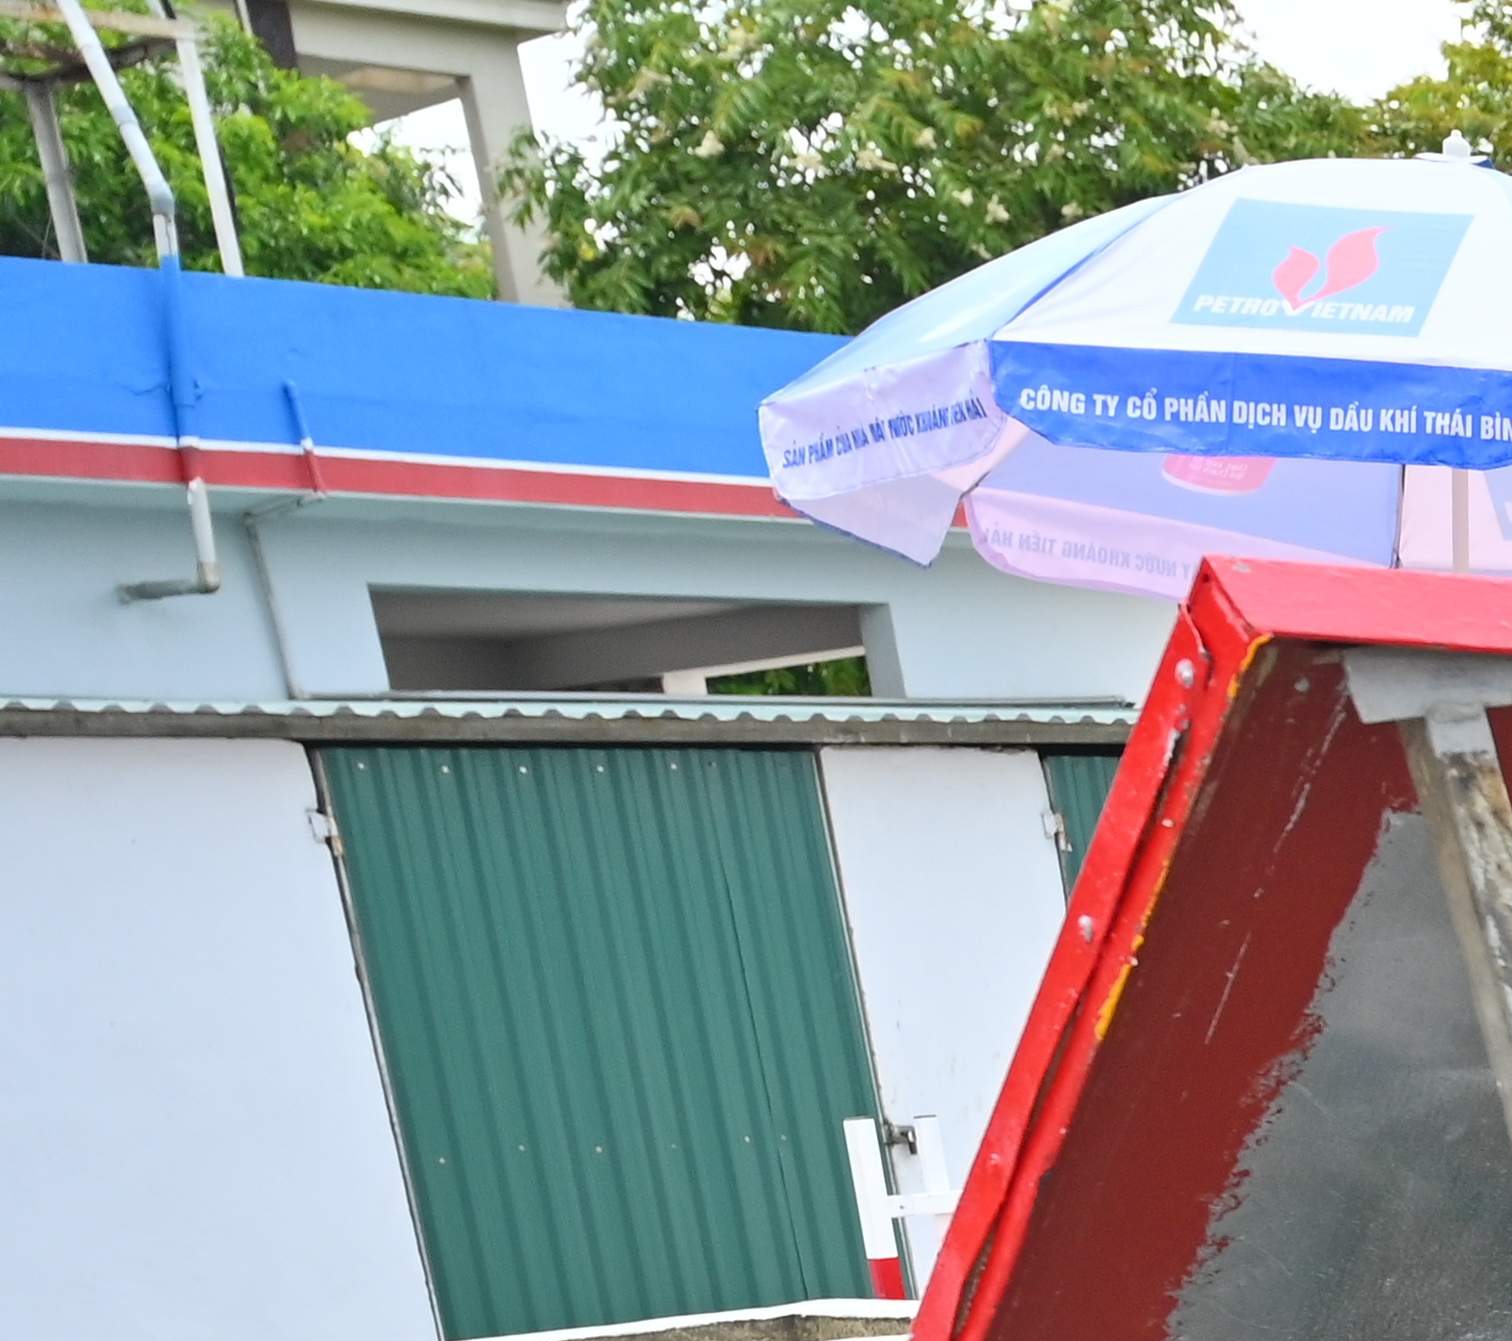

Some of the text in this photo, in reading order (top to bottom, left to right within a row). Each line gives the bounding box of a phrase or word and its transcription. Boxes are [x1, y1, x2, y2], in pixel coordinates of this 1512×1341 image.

[1193, 294, 1415, 324] PETROVIETNAM
[1020, 384, 1085, 415] CÔNG
[1092, 394, 1119, 417] TY
[1126, 387, 1157, 420] CỔ
[1164, 390, 1226, 423] PHẦN
[1232, 400, 1286, 429] DỊCH
[1294, 404, 1322, 434] VỤ
[1329, 401, 1373, 432] DẦU
[1379, 405, 1417, 433] KHÍ
[1423, 408, 1472, 438] THÁI
